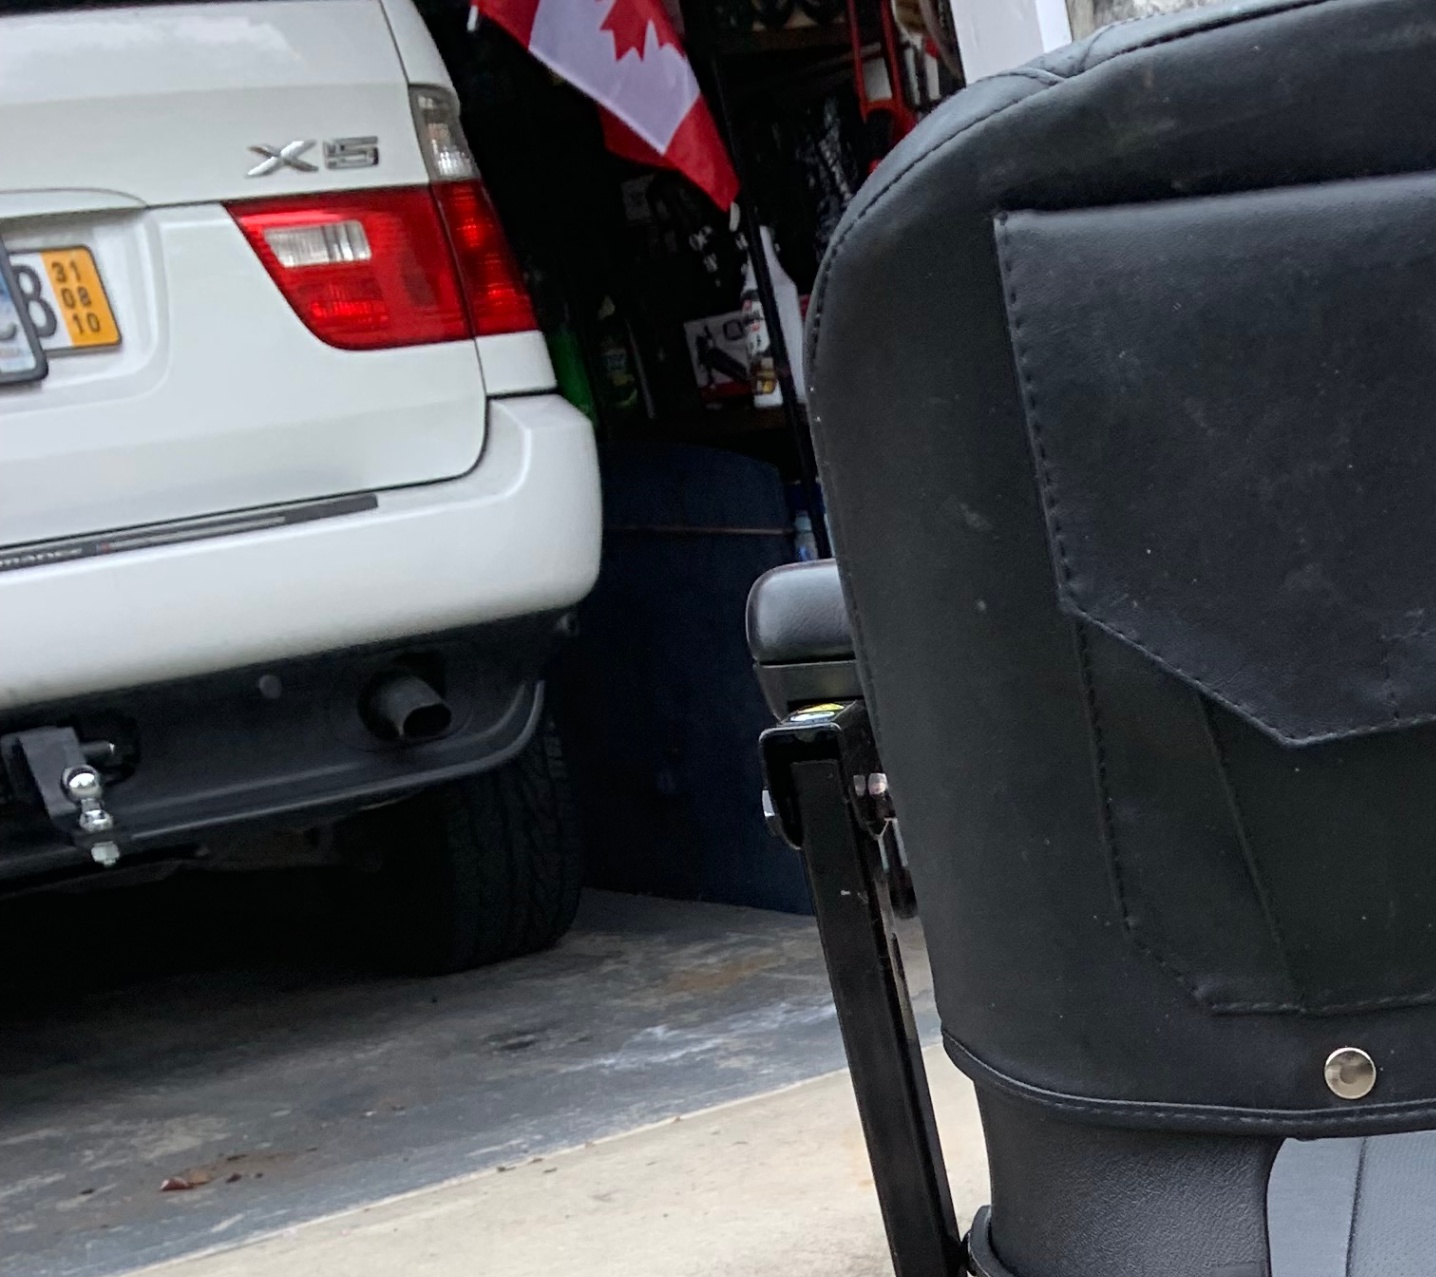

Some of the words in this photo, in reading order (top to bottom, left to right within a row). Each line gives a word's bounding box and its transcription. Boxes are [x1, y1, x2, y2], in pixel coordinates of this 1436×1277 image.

[245, 136, 379, 178] X5
[51, 261, 81, 284] 31
[61, 286, 92, 310] 08
[72, 312, 101, 335] 10
